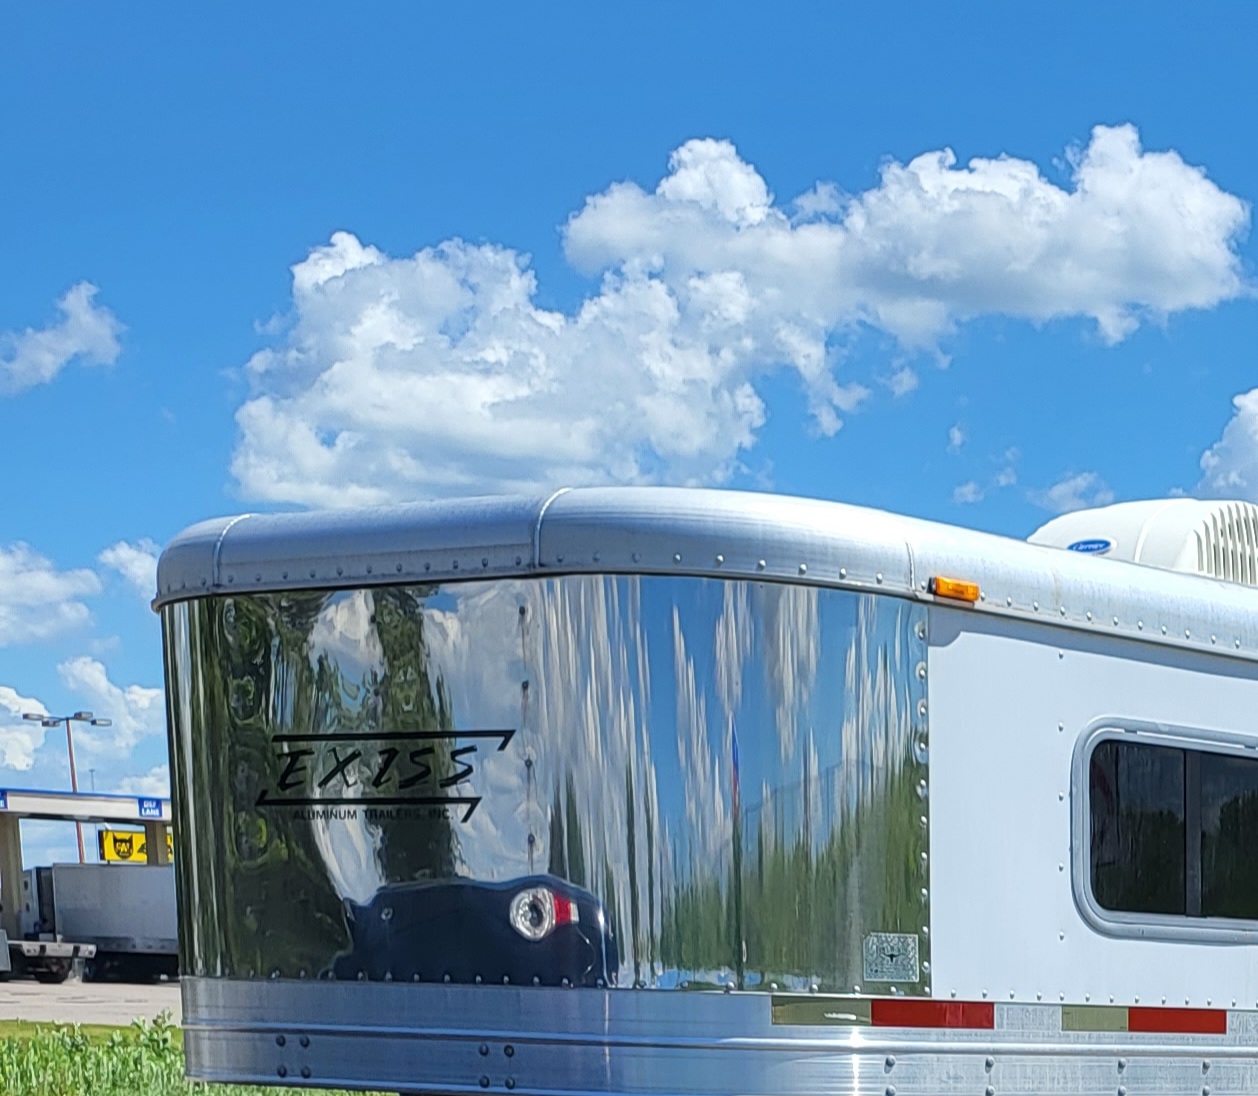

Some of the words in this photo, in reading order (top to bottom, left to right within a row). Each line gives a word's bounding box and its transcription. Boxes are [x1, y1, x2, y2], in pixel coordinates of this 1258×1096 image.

[275, 744, 479, 792] EXISS
[292, 809, 358, 821] ALUMINUM
[363, 809, 422, 821] TRAILERS
